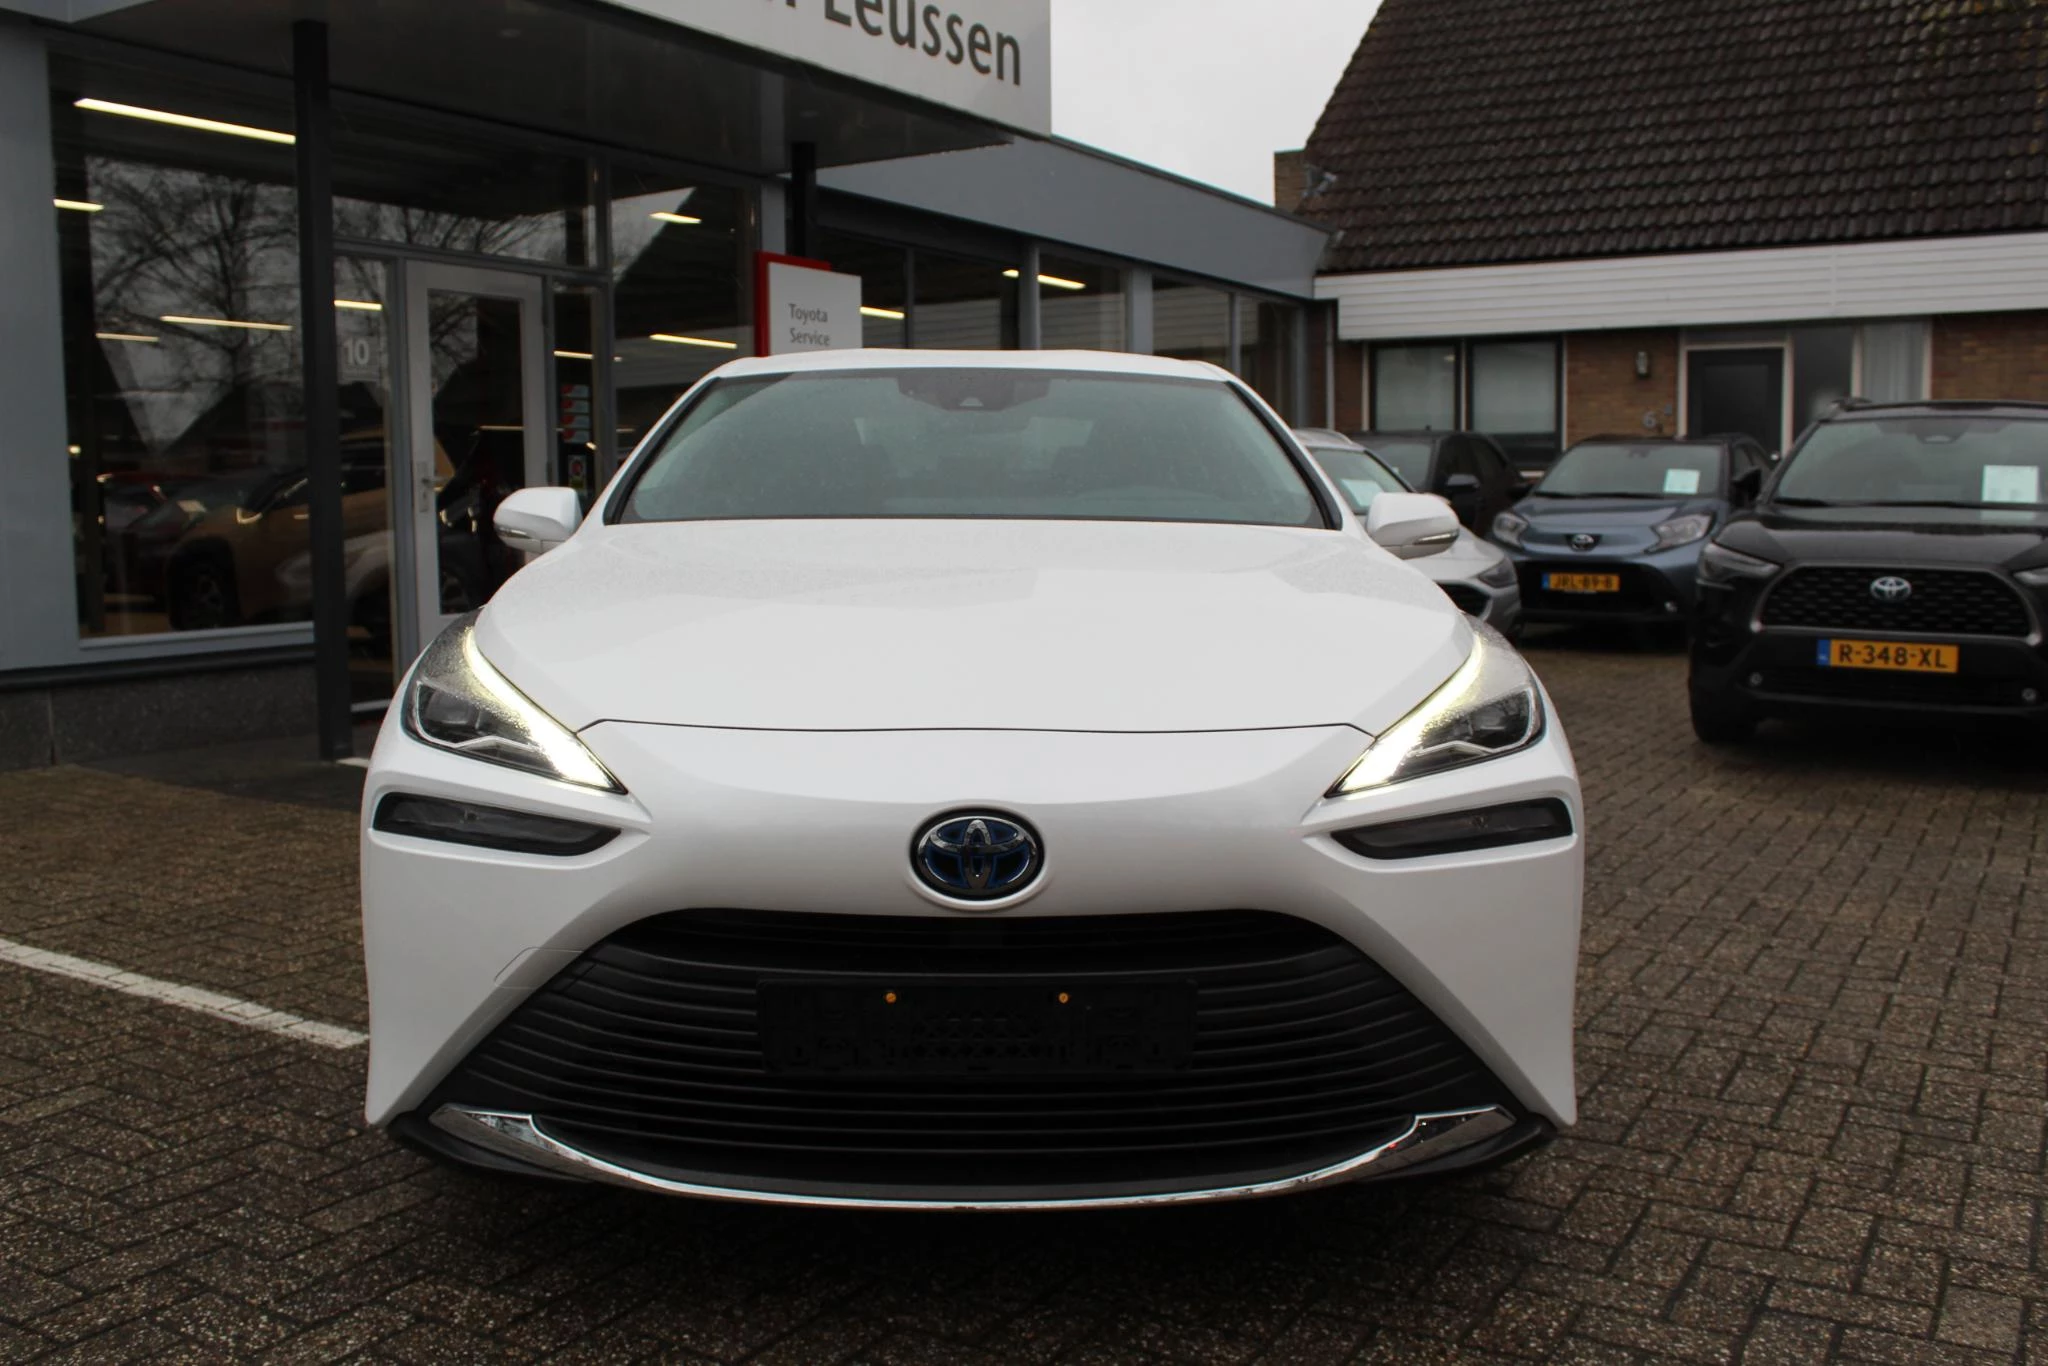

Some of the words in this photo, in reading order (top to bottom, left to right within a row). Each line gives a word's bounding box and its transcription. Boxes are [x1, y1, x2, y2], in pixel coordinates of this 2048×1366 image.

[788, 303, 828, 325] Toyota
[790, 328, 830, 346] Service
[343, 338, 370, 366] 10
[1839, 643, 1948, 668] R-348-XL
